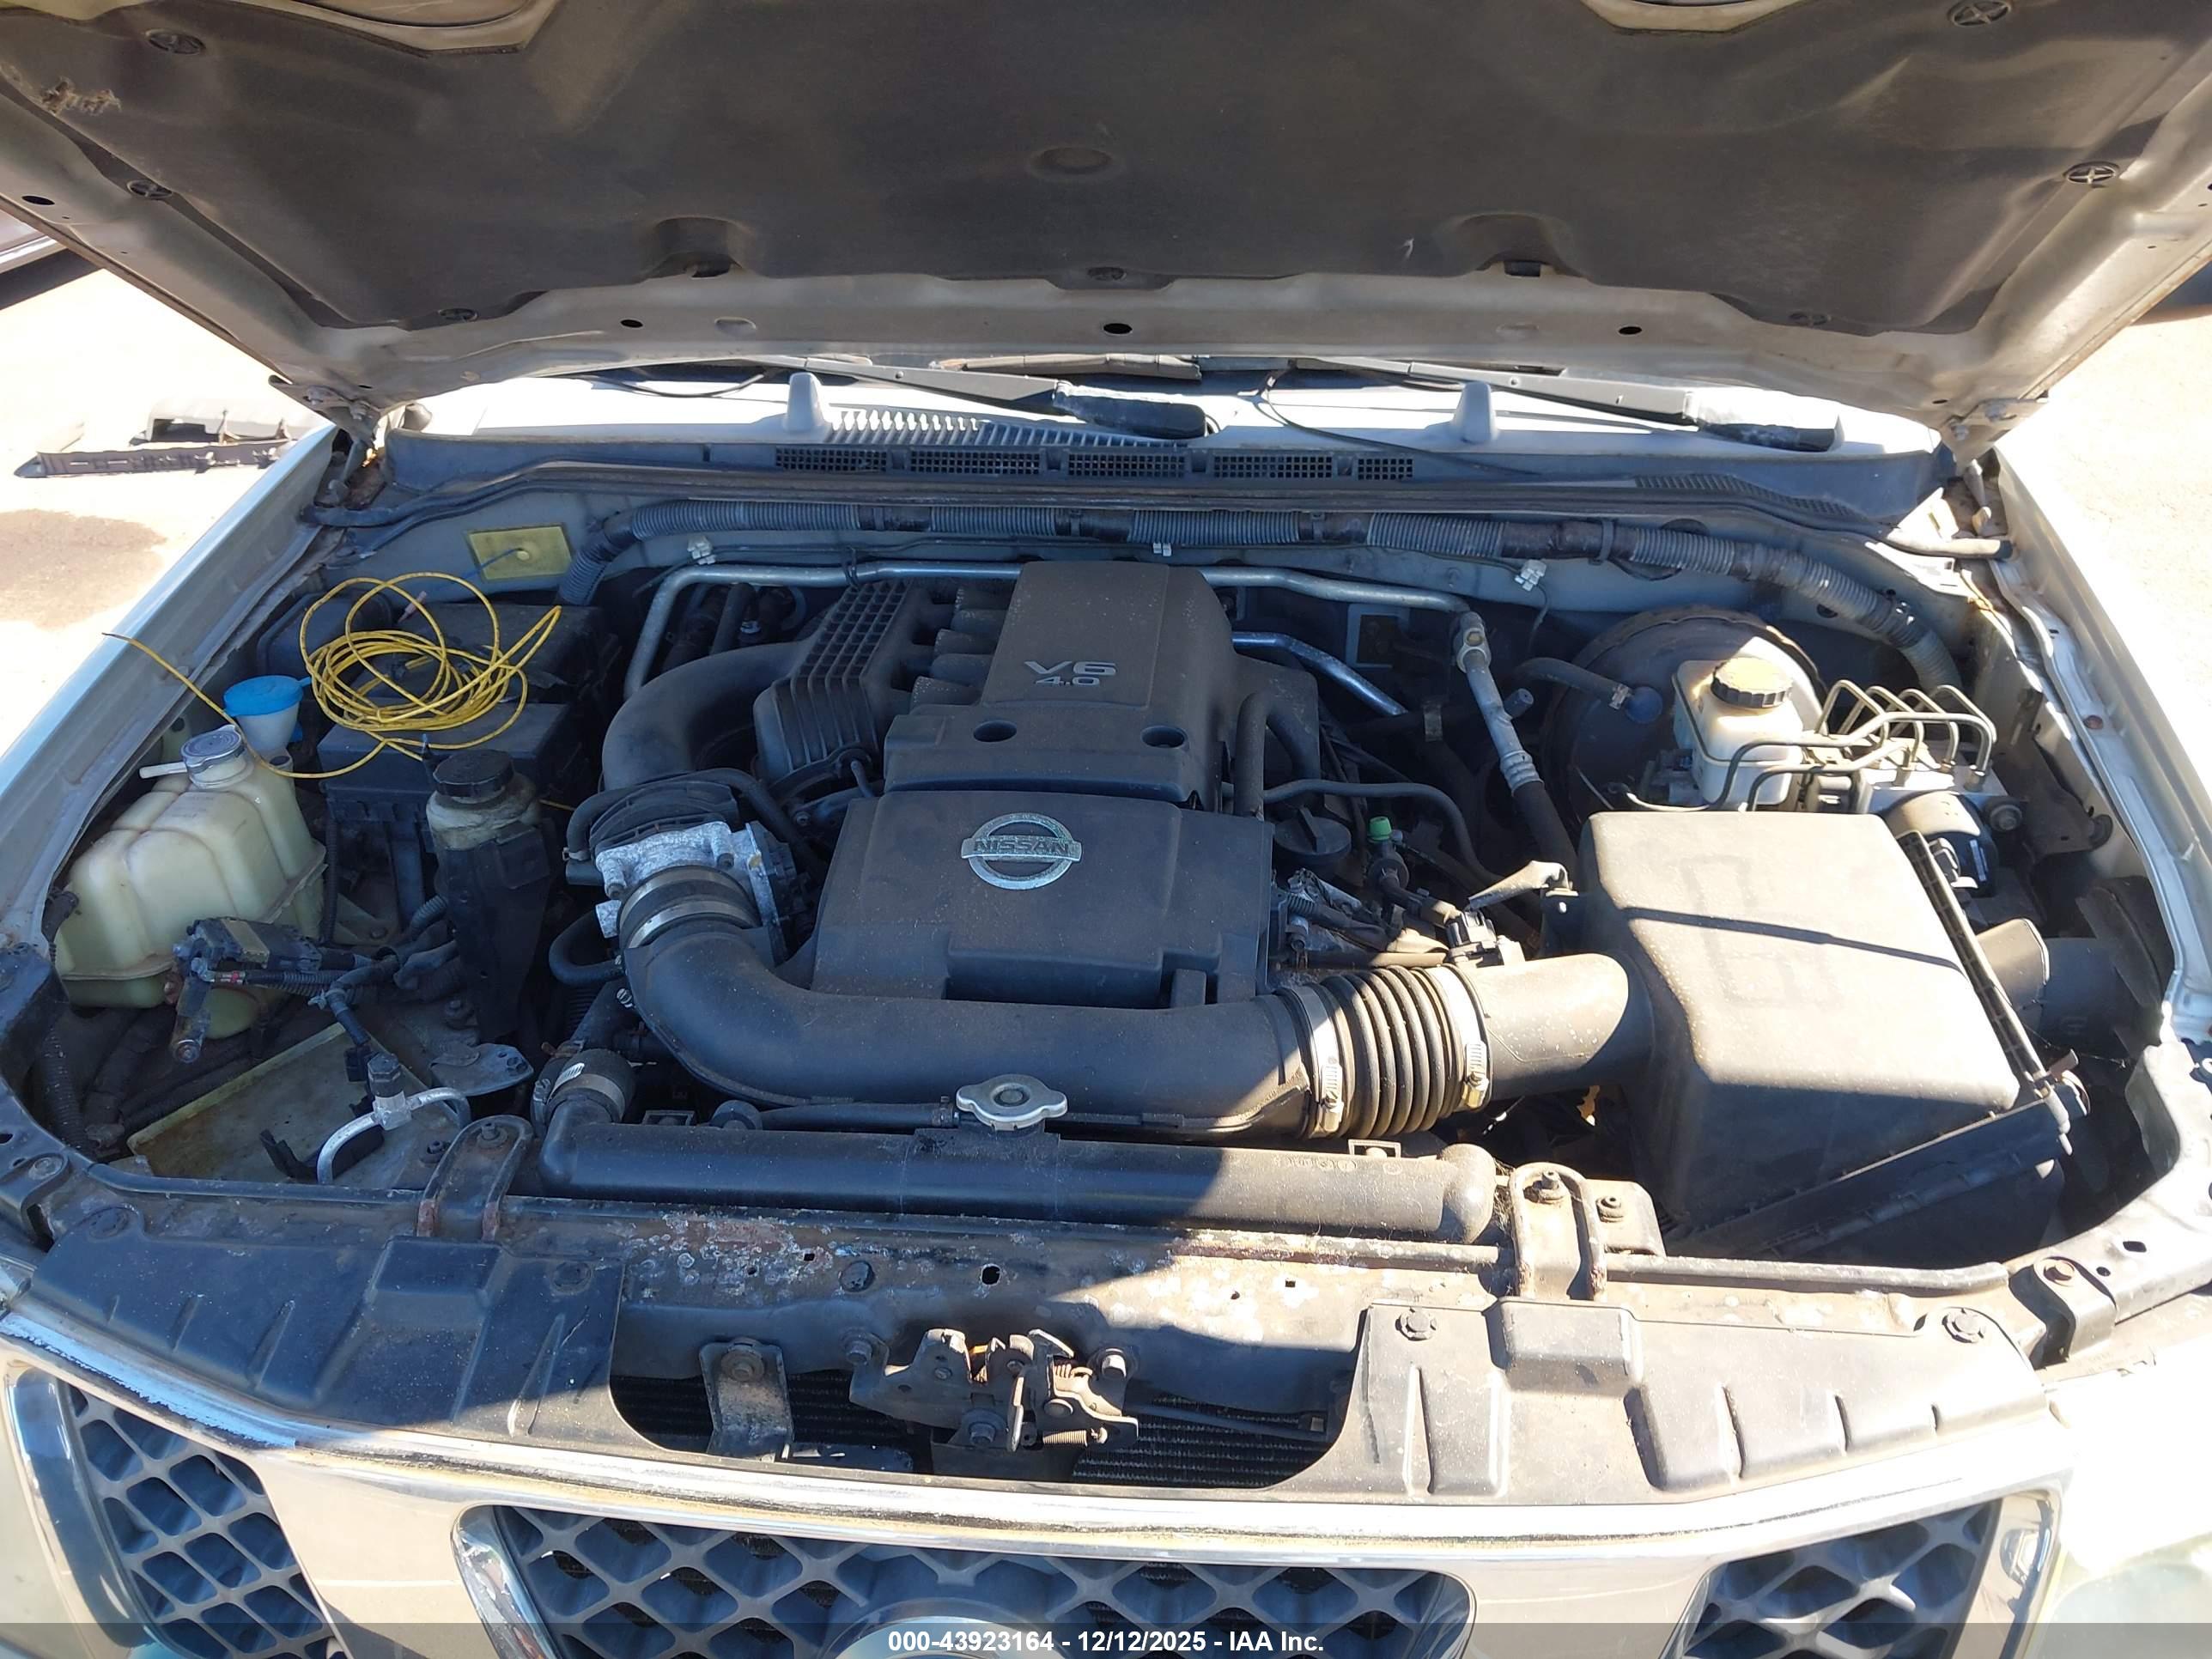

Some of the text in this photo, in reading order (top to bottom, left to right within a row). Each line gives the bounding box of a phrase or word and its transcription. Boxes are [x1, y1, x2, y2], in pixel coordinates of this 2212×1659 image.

[1024, 660, 1116, 676] V6
[1034, 676, 1100, 686] 4.0
[973, 839, 1070, 855] NISSAN
